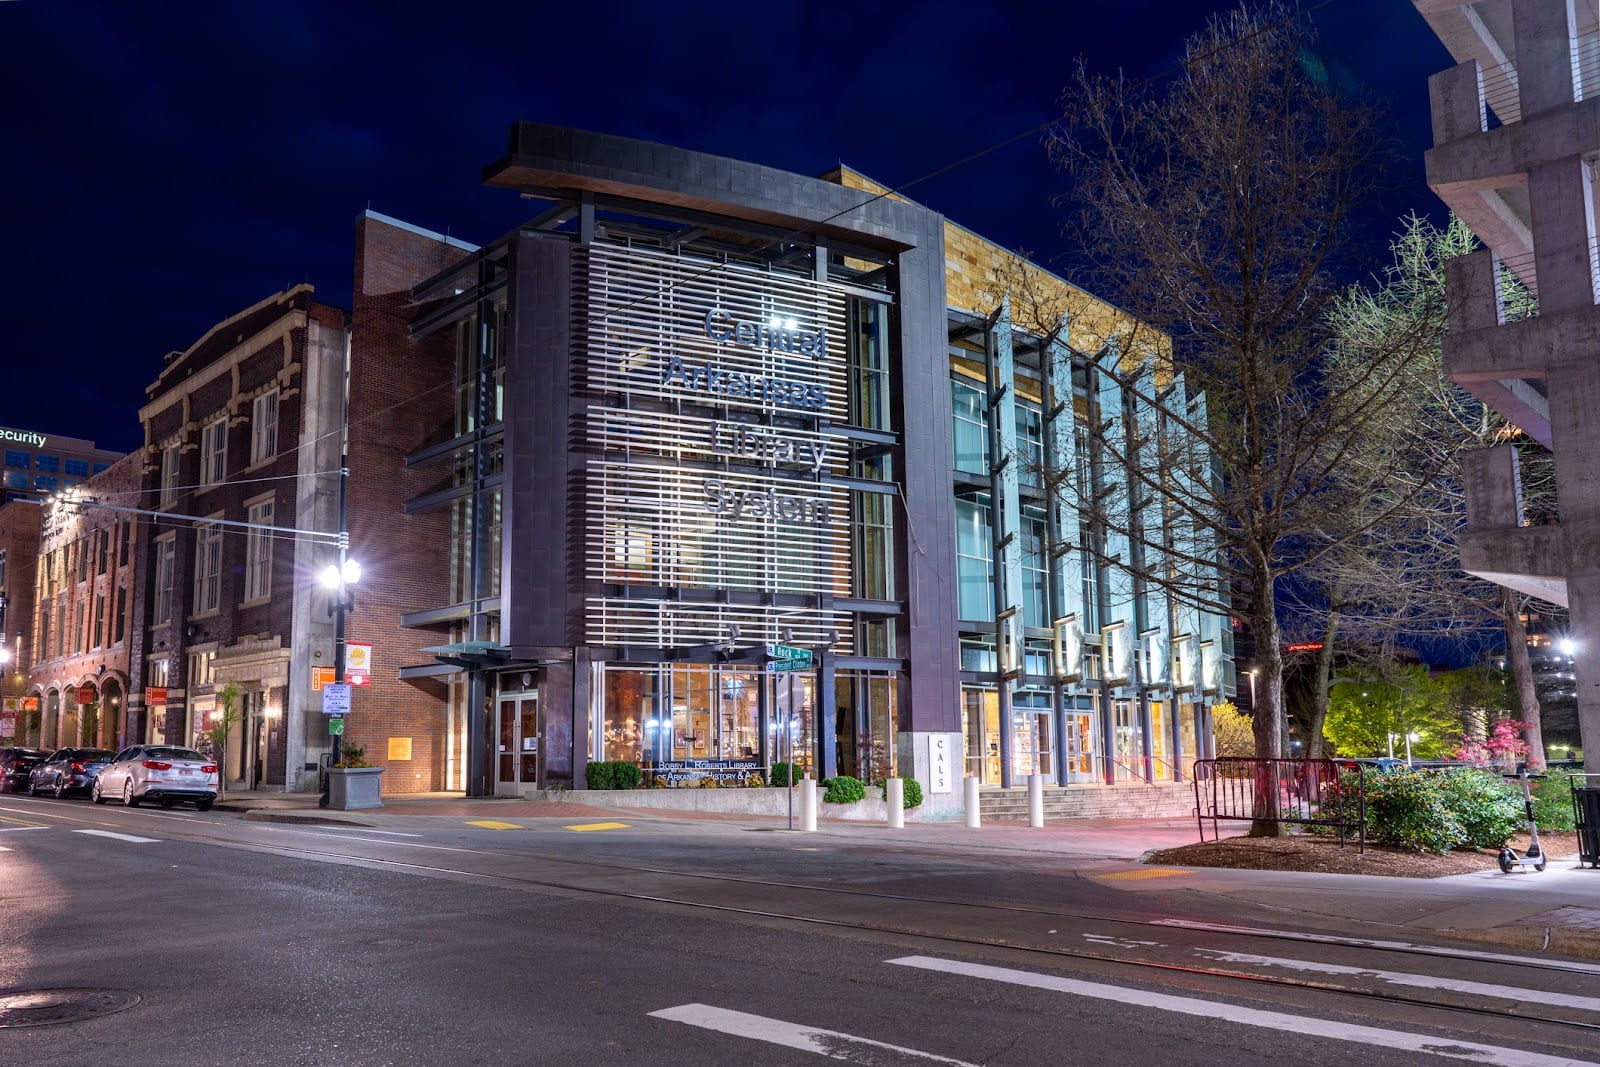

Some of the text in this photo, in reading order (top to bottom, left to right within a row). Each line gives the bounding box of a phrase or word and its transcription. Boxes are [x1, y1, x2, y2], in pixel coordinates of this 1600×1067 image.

[705, 308, 828, 359] Central
[664, 355, 828, 409] Arkansas
[711, 421, 828, 473] Library
[703, 479, 832, 523] System
[659, 760, 684, 770] BOBBY
[729, 760, 757, 770] LIBRARY
[667, 771, 703, 780] ARKANSA
